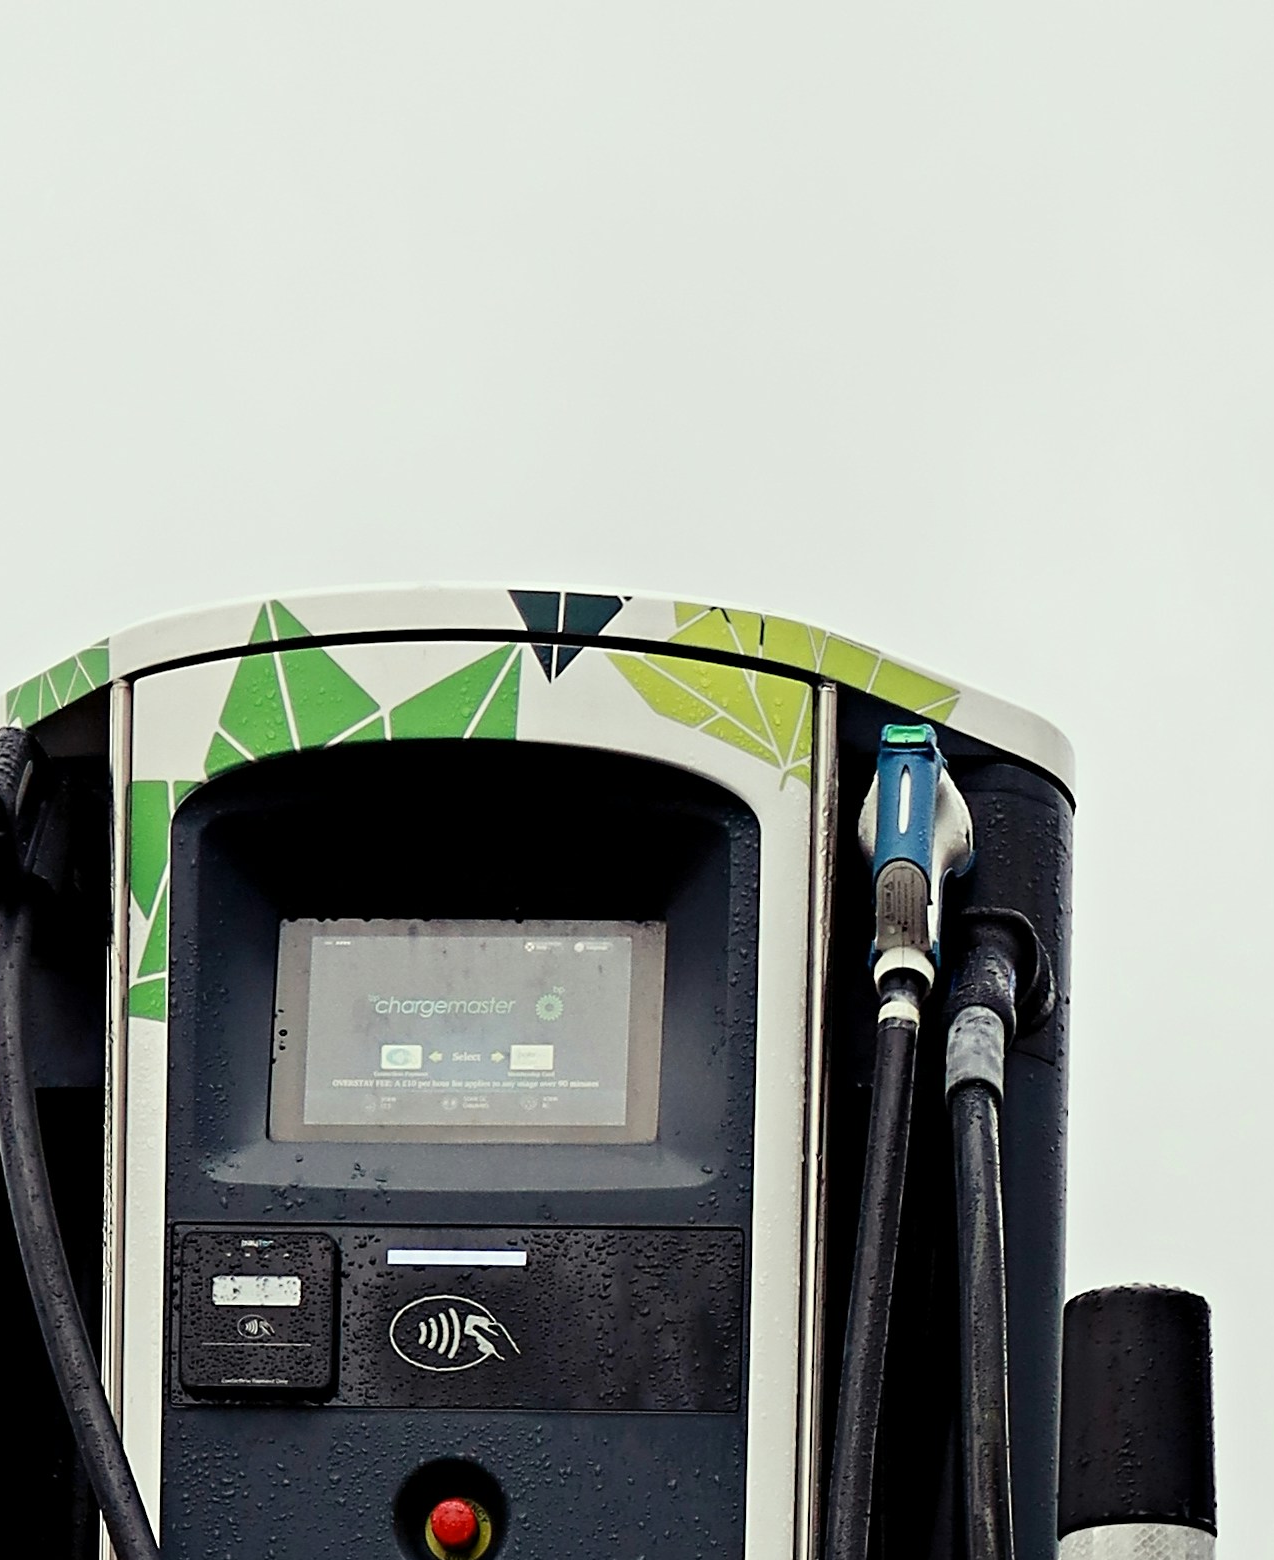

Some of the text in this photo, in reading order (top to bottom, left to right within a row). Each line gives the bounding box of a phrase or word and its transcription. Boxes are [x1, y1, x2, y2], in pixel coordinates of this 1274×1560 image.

[375, 996, 516, 1018] chargemaster
[452, 1051, 481, 1062] Select
[332, 1080, 374, 1088] OVERSTAY
[393, 1080, 401, 1088] A
